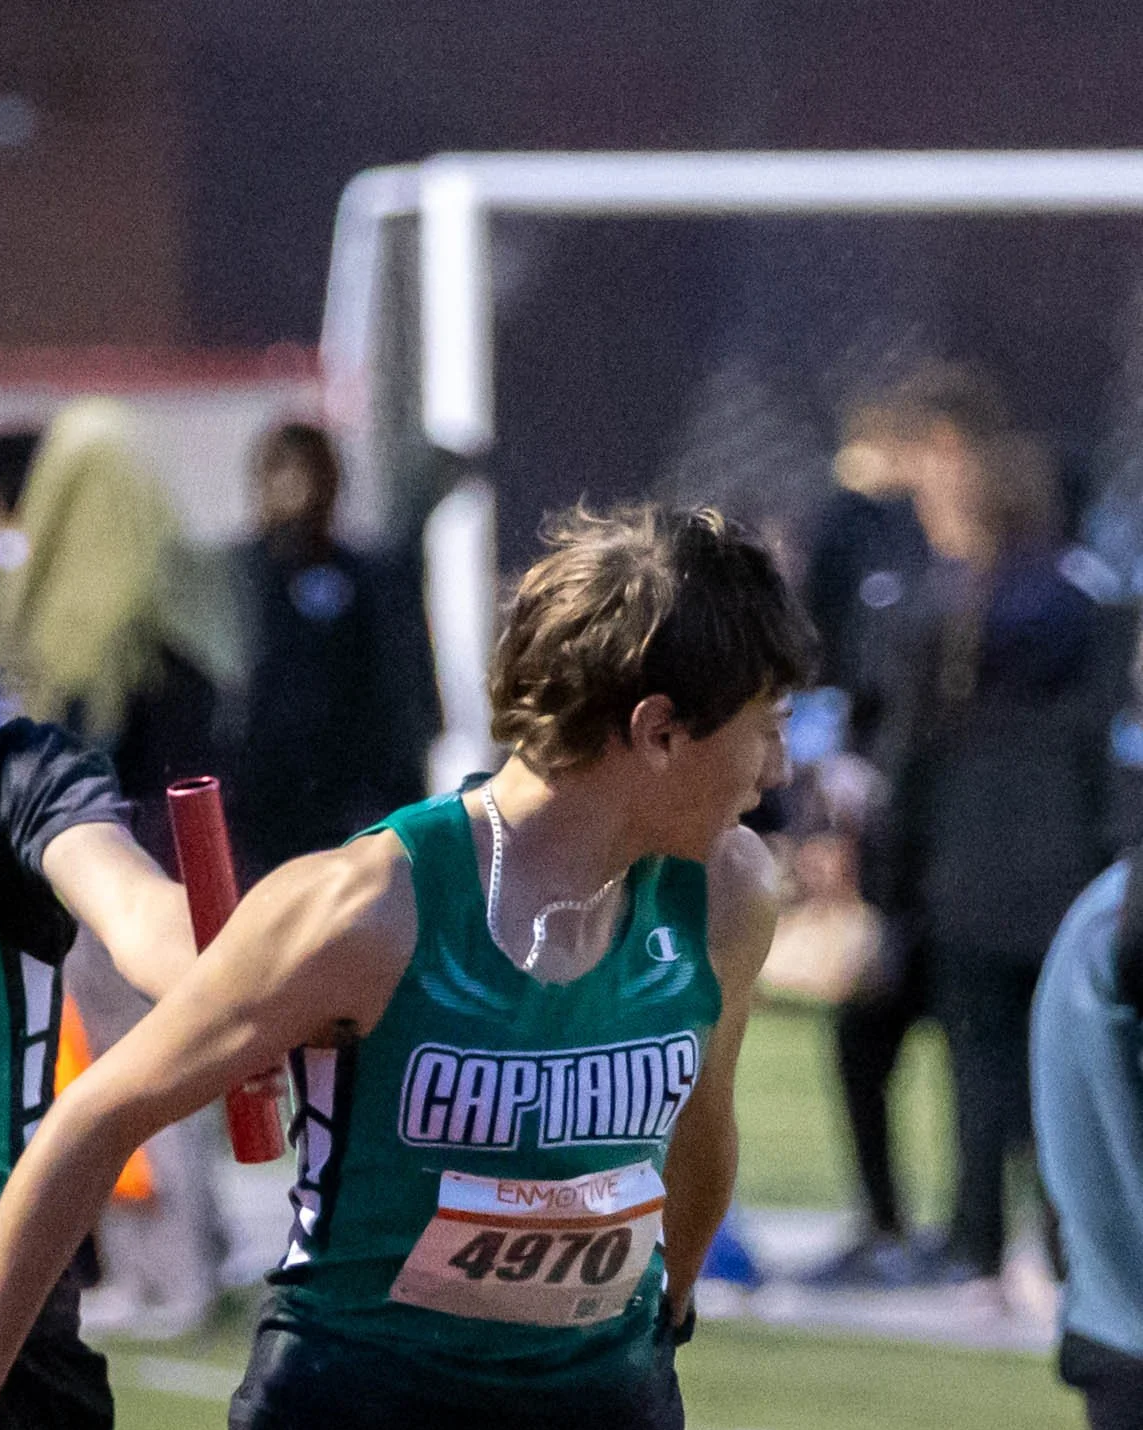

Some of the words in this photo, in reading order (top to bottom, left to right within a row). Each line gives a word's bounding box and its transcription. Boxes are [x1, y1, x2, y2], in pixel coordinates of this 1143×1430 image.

[399, 1029, 700, 1149] CAPTAINS
[496, 1172, 620, 1208] ENMOTIVE
[449, 1227, 633, 1285] 4970
